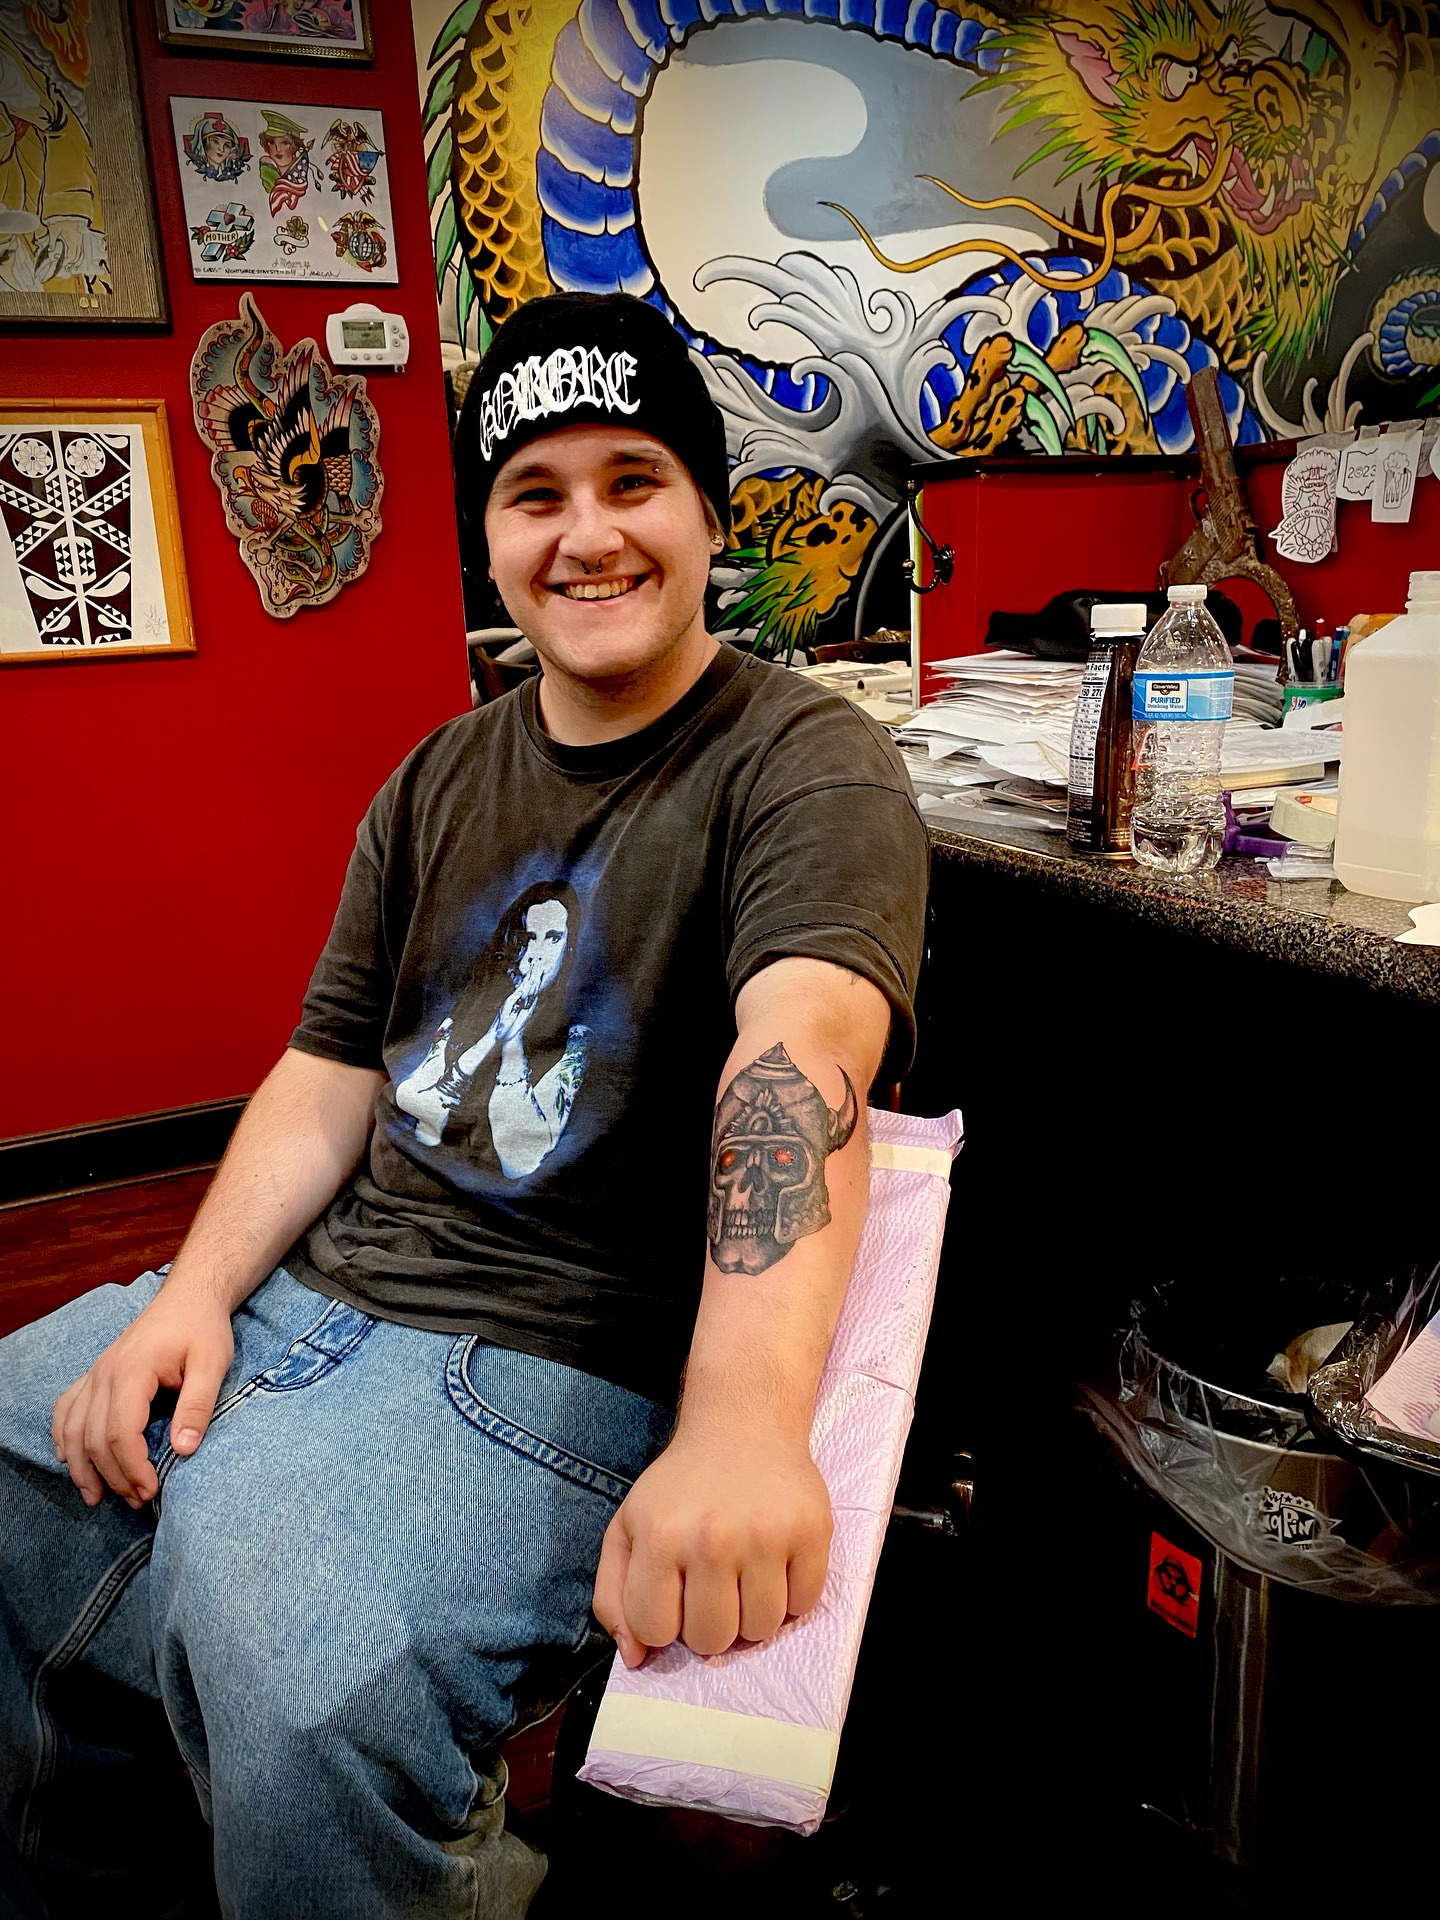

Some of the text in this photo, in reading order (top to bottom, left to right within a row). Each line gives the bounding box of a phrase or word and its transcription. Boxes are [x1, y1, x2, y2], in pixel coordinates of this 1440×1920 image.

[205, 232, 237, 243] MOTHER
[1284, 508, 1329, 529] WORLD WAR
[1090, 663, 1110, 671] Facts
[1150, 696, 1181, 704] PURIFIED
